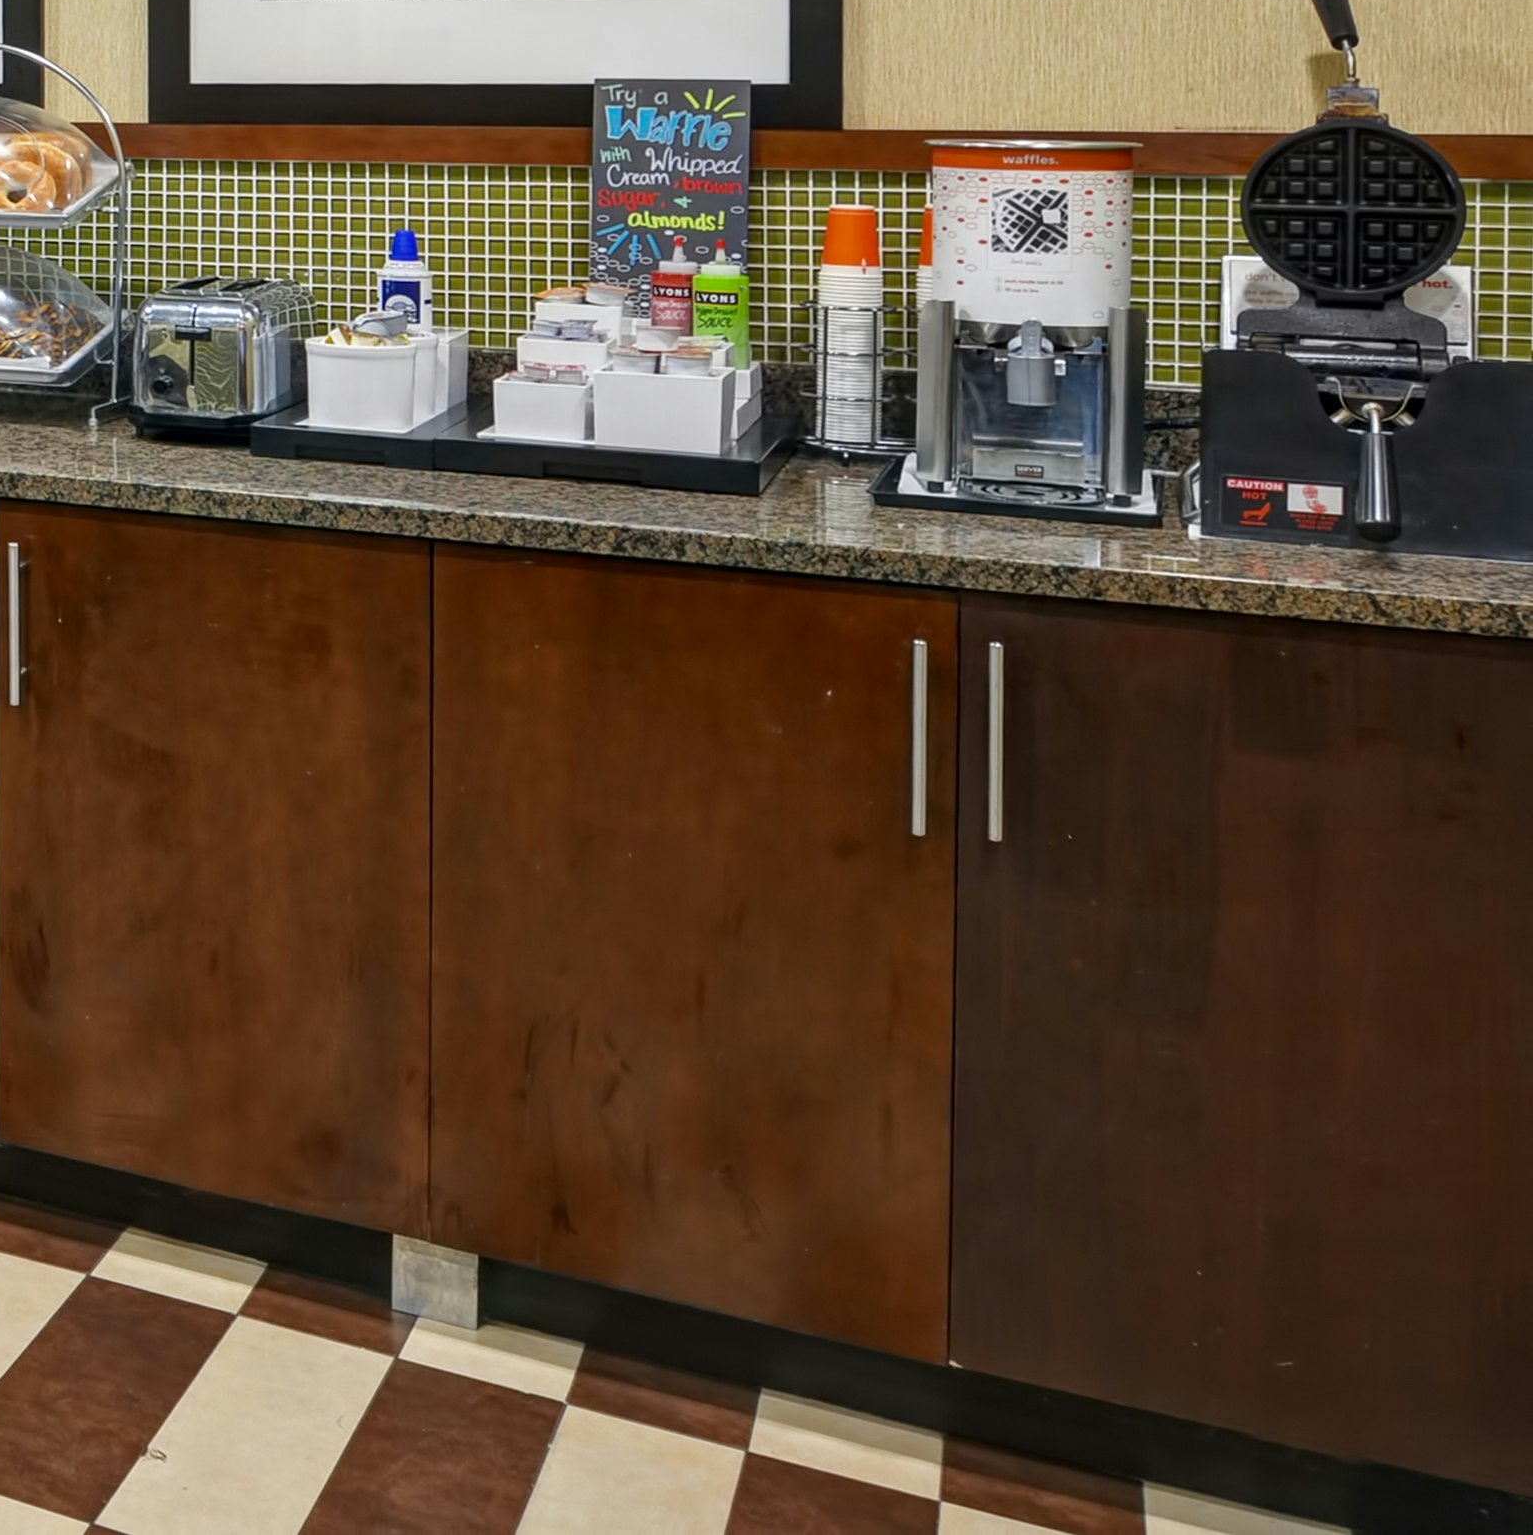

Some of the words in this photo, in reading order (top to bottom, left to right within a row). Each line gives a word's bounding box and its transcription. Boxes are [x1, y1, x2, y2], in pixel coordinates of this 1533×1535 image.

[600, 83, 637, 109] Try
[654, 91, 669, 105] a
[605, 105, 733, 152] Waffle
[600, 146, 632, 164] with
[645, 146, 744, 177] Whipped
[1002, 154, 1059, 165] waffles.
[682, 177, 744, 195] brown
[654, 287, 690, 297] LYONS
[697, 293, 736, 304] LYONS
[1227, 478, 1284, 491] CAUTION
[1242, 491, 1268, 500] HOT
